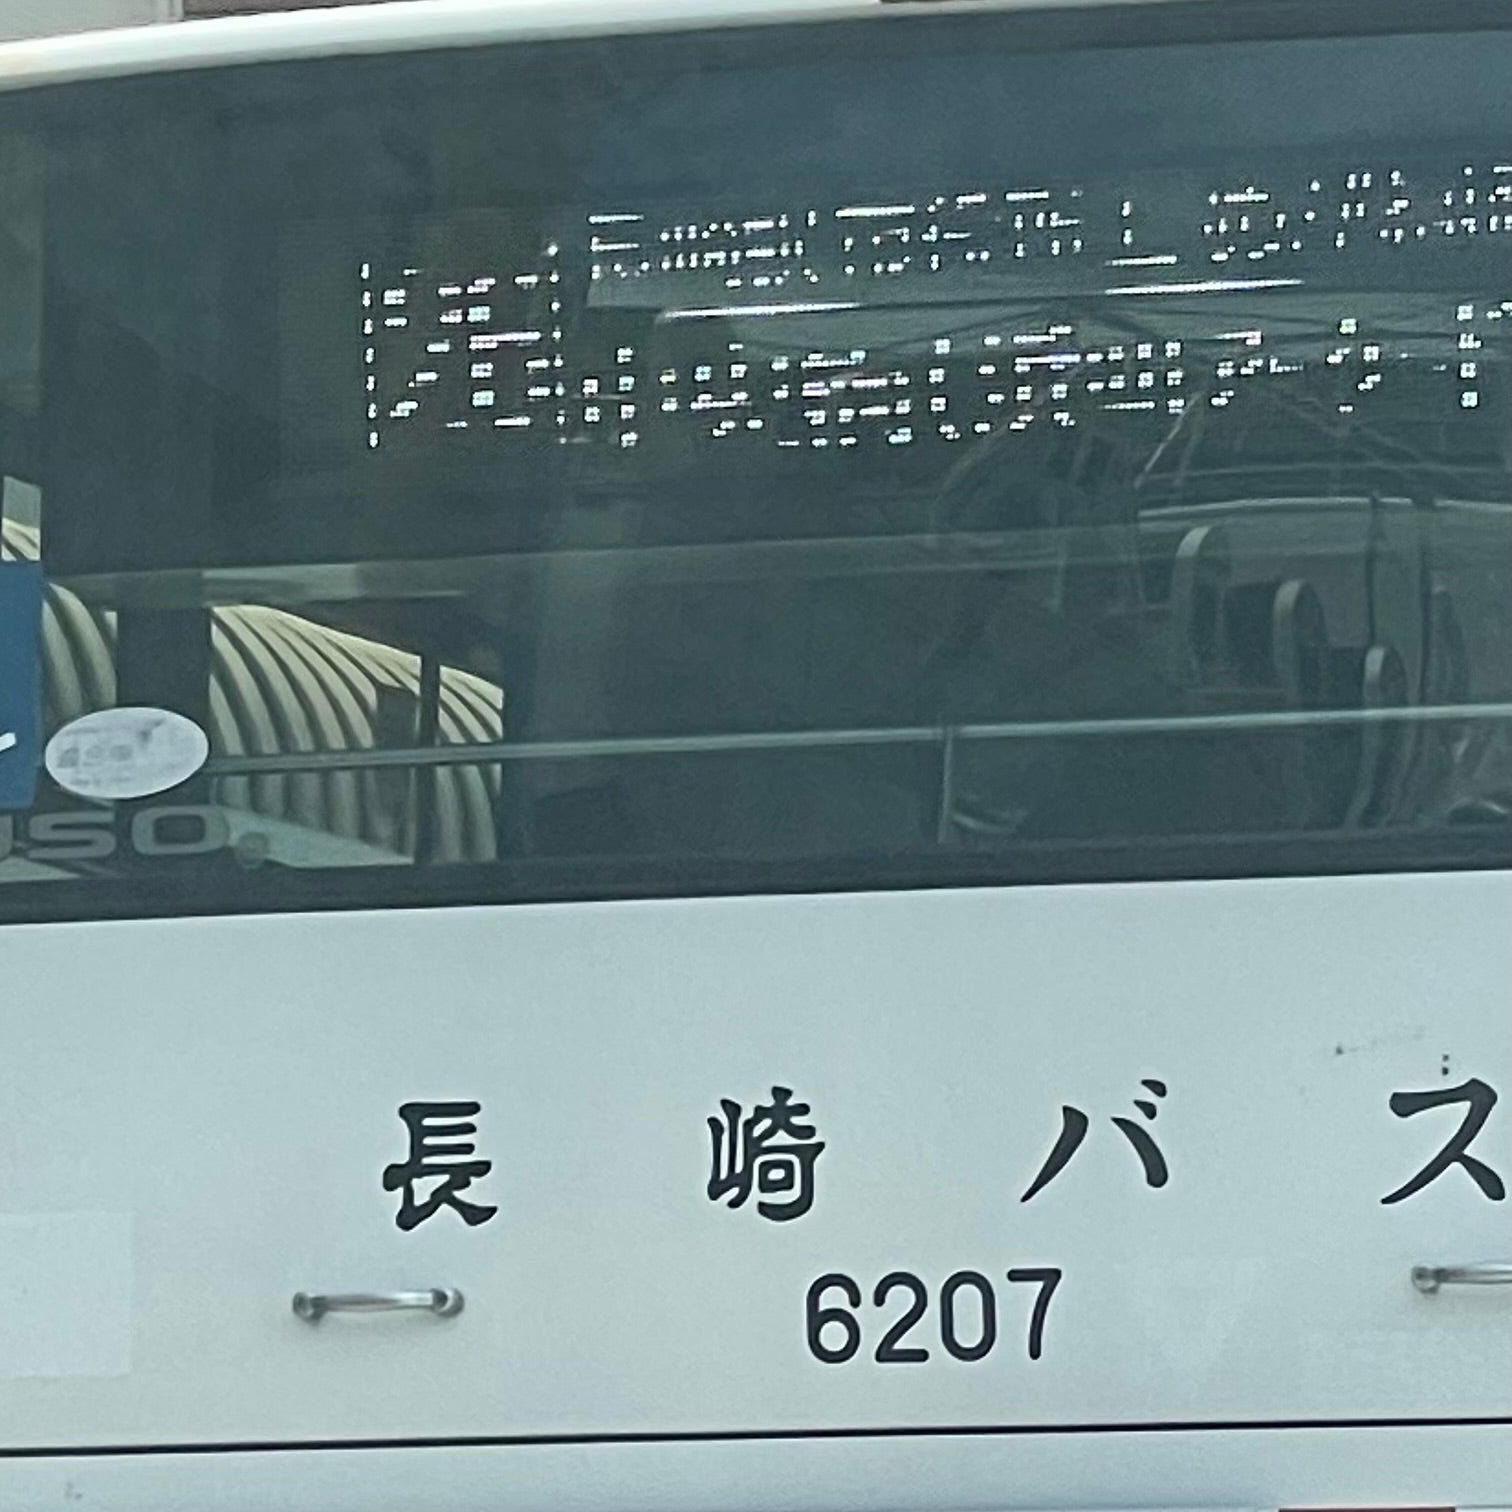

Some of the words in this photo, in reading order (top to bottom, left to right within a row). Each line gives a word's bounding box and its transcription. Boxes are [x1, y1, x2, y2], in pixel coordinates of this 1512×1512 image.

[383, 1078, 1506, 1232] 長崎バス
[805, 1267, 1062, 1365] 6207
